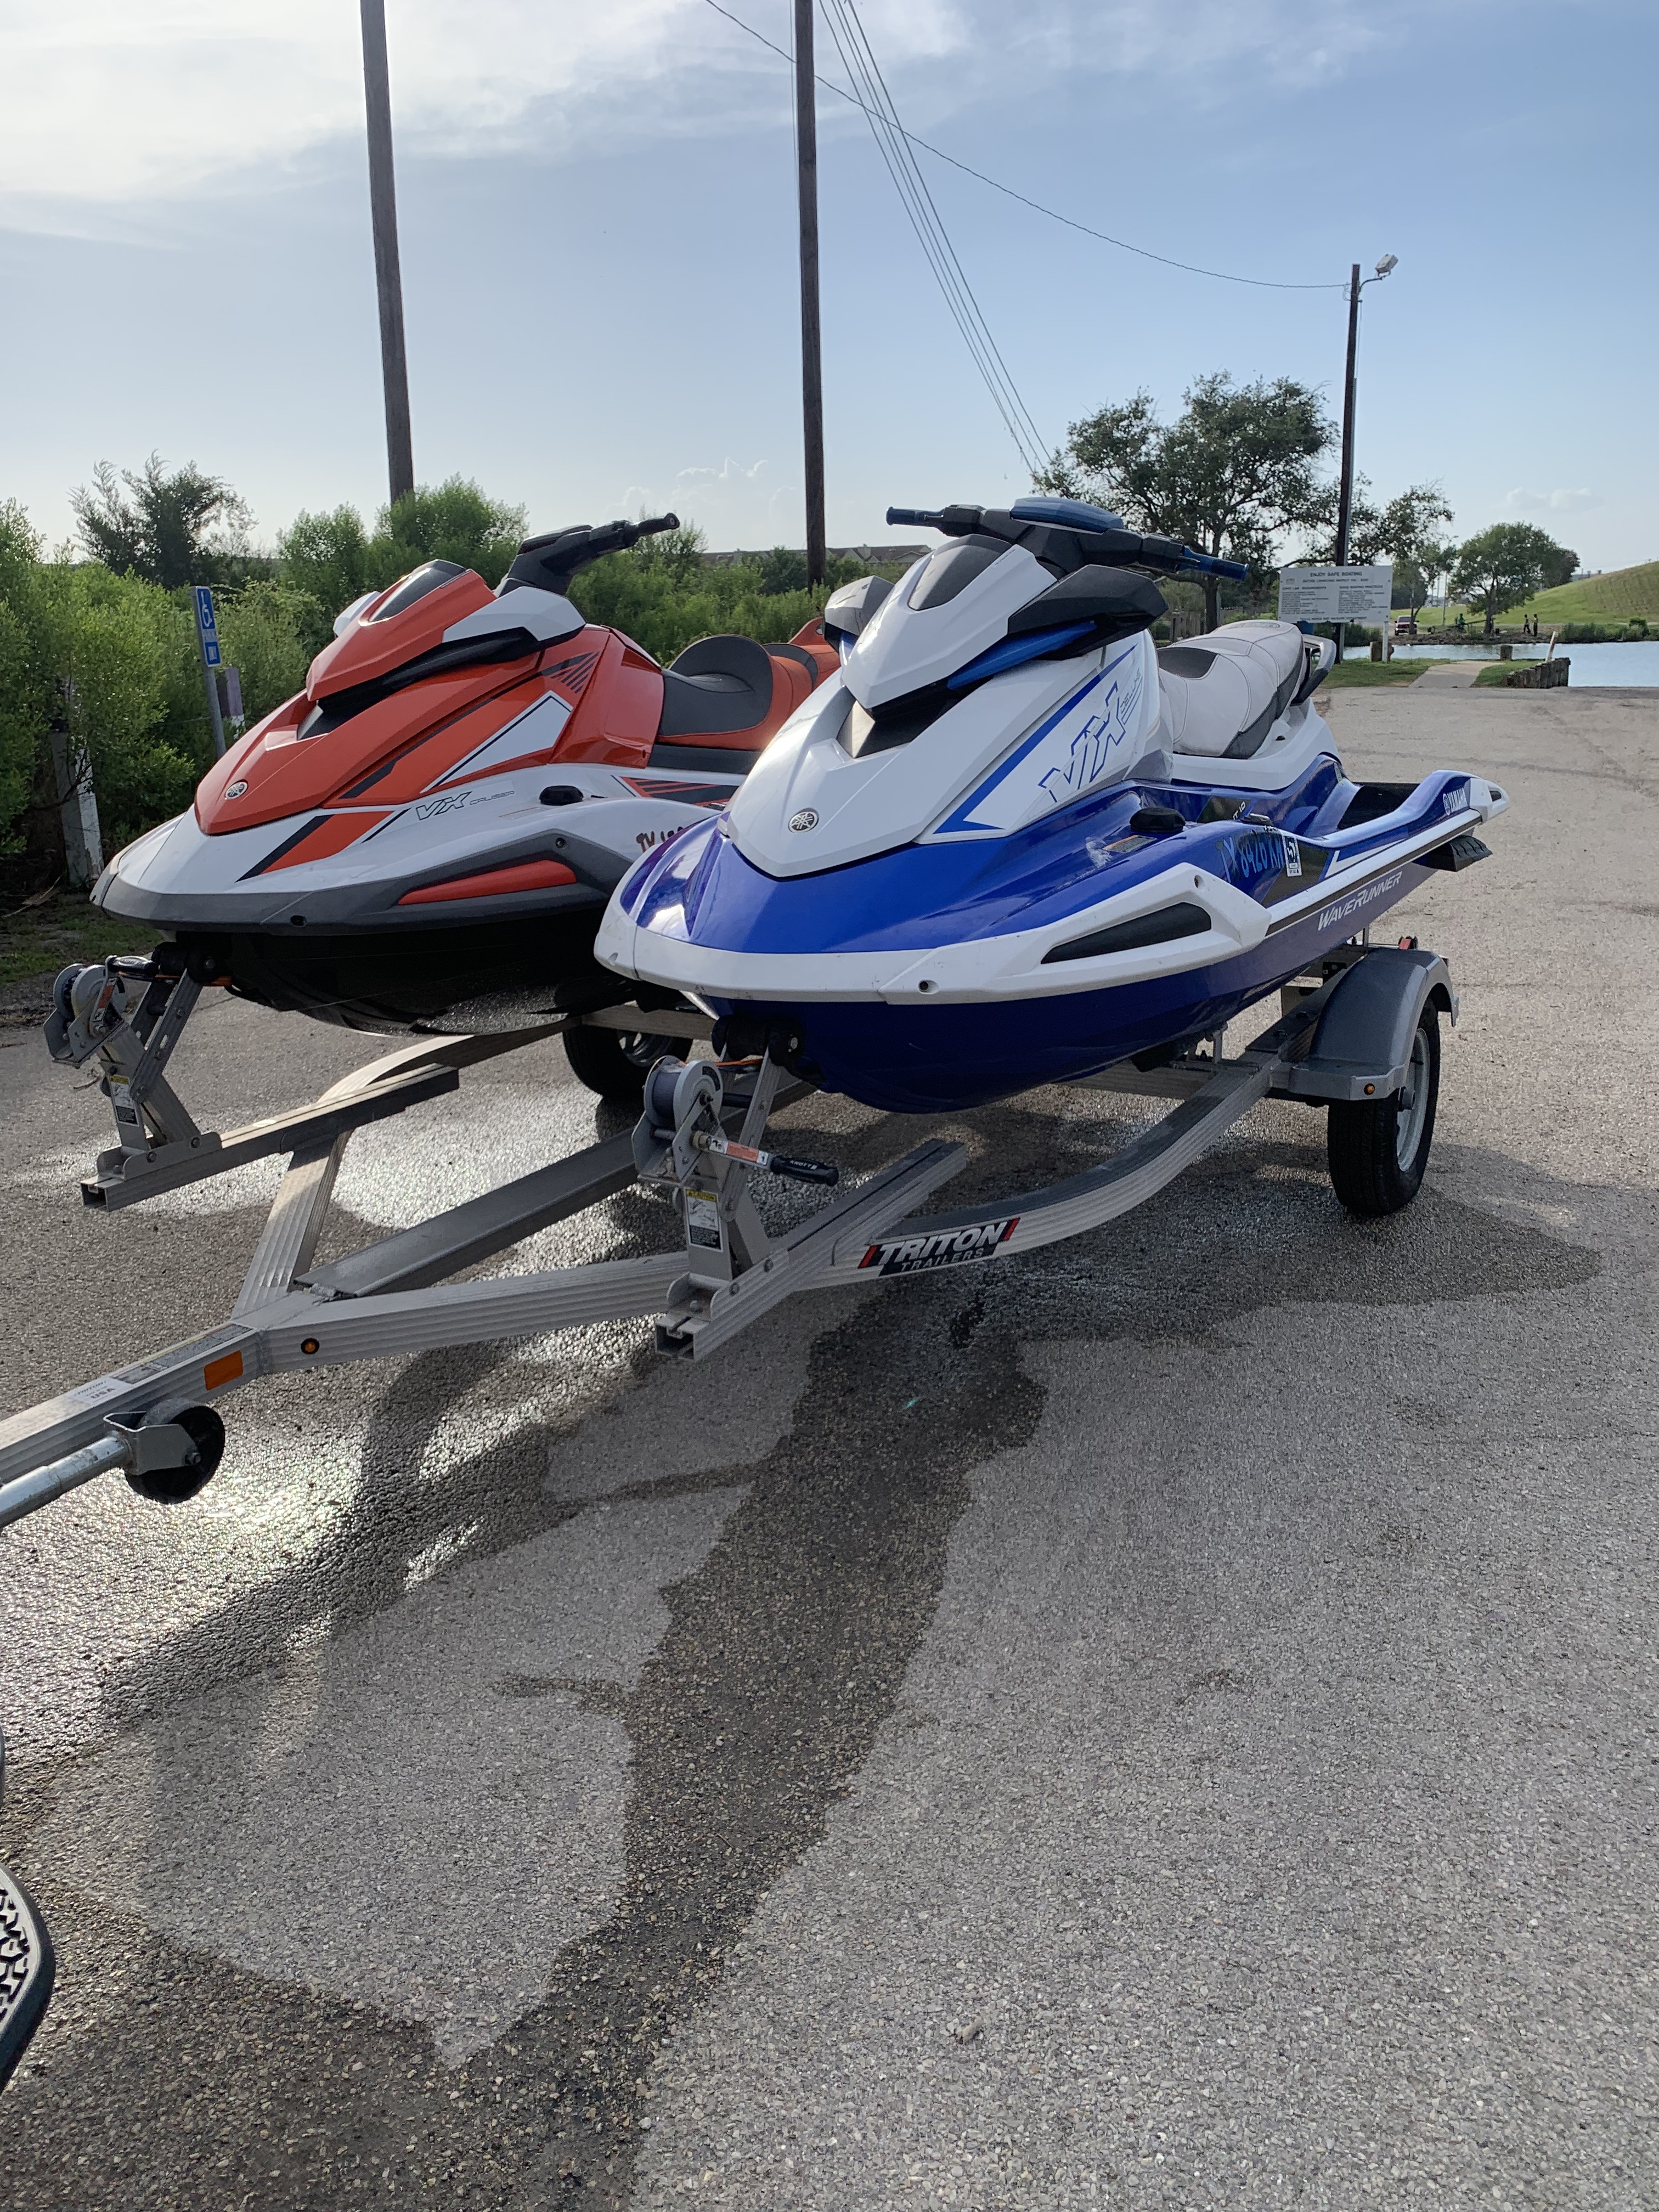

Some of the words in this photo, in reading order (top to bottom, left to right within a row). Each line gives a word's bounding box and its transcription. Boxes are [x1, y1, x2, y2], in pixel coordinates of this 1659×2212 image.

[1038, 681, 1126, 803] VX
[416, 791, 472, 821] VX
[470, 791, 515, 805] CRUISER
[878, 1221, 1009, 1264] TRITON
[900, 1248, 985, 1272] TRAILERS
